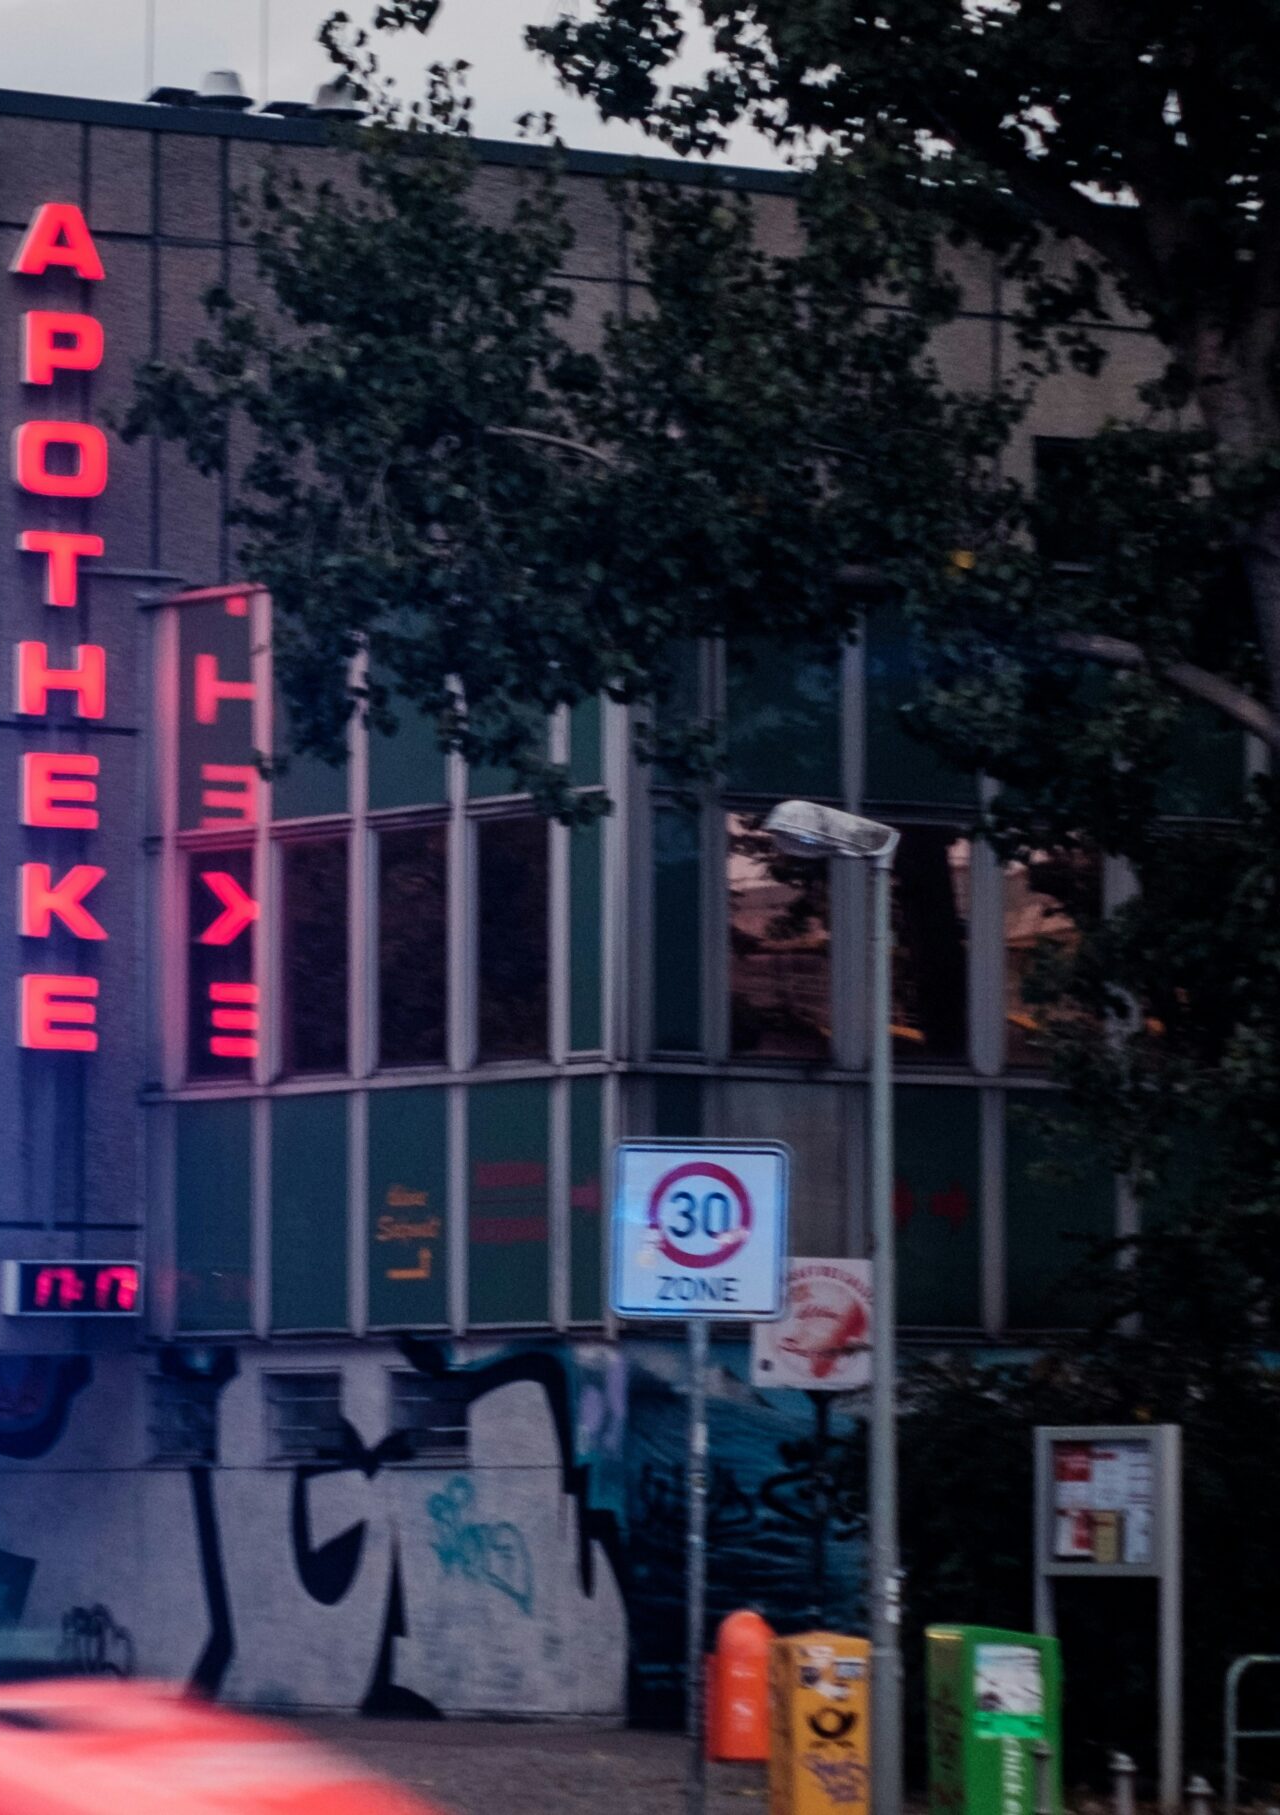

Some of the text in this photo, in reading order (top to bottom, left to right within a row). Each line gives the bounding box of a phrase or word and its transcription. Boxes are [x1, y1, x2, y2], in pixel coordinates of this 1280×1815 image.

[10, 202, 108, 1052] APOTHEKE
[669, 1191, 731, 1238] 30
[656, 1275, 740, 1302] ZONE
